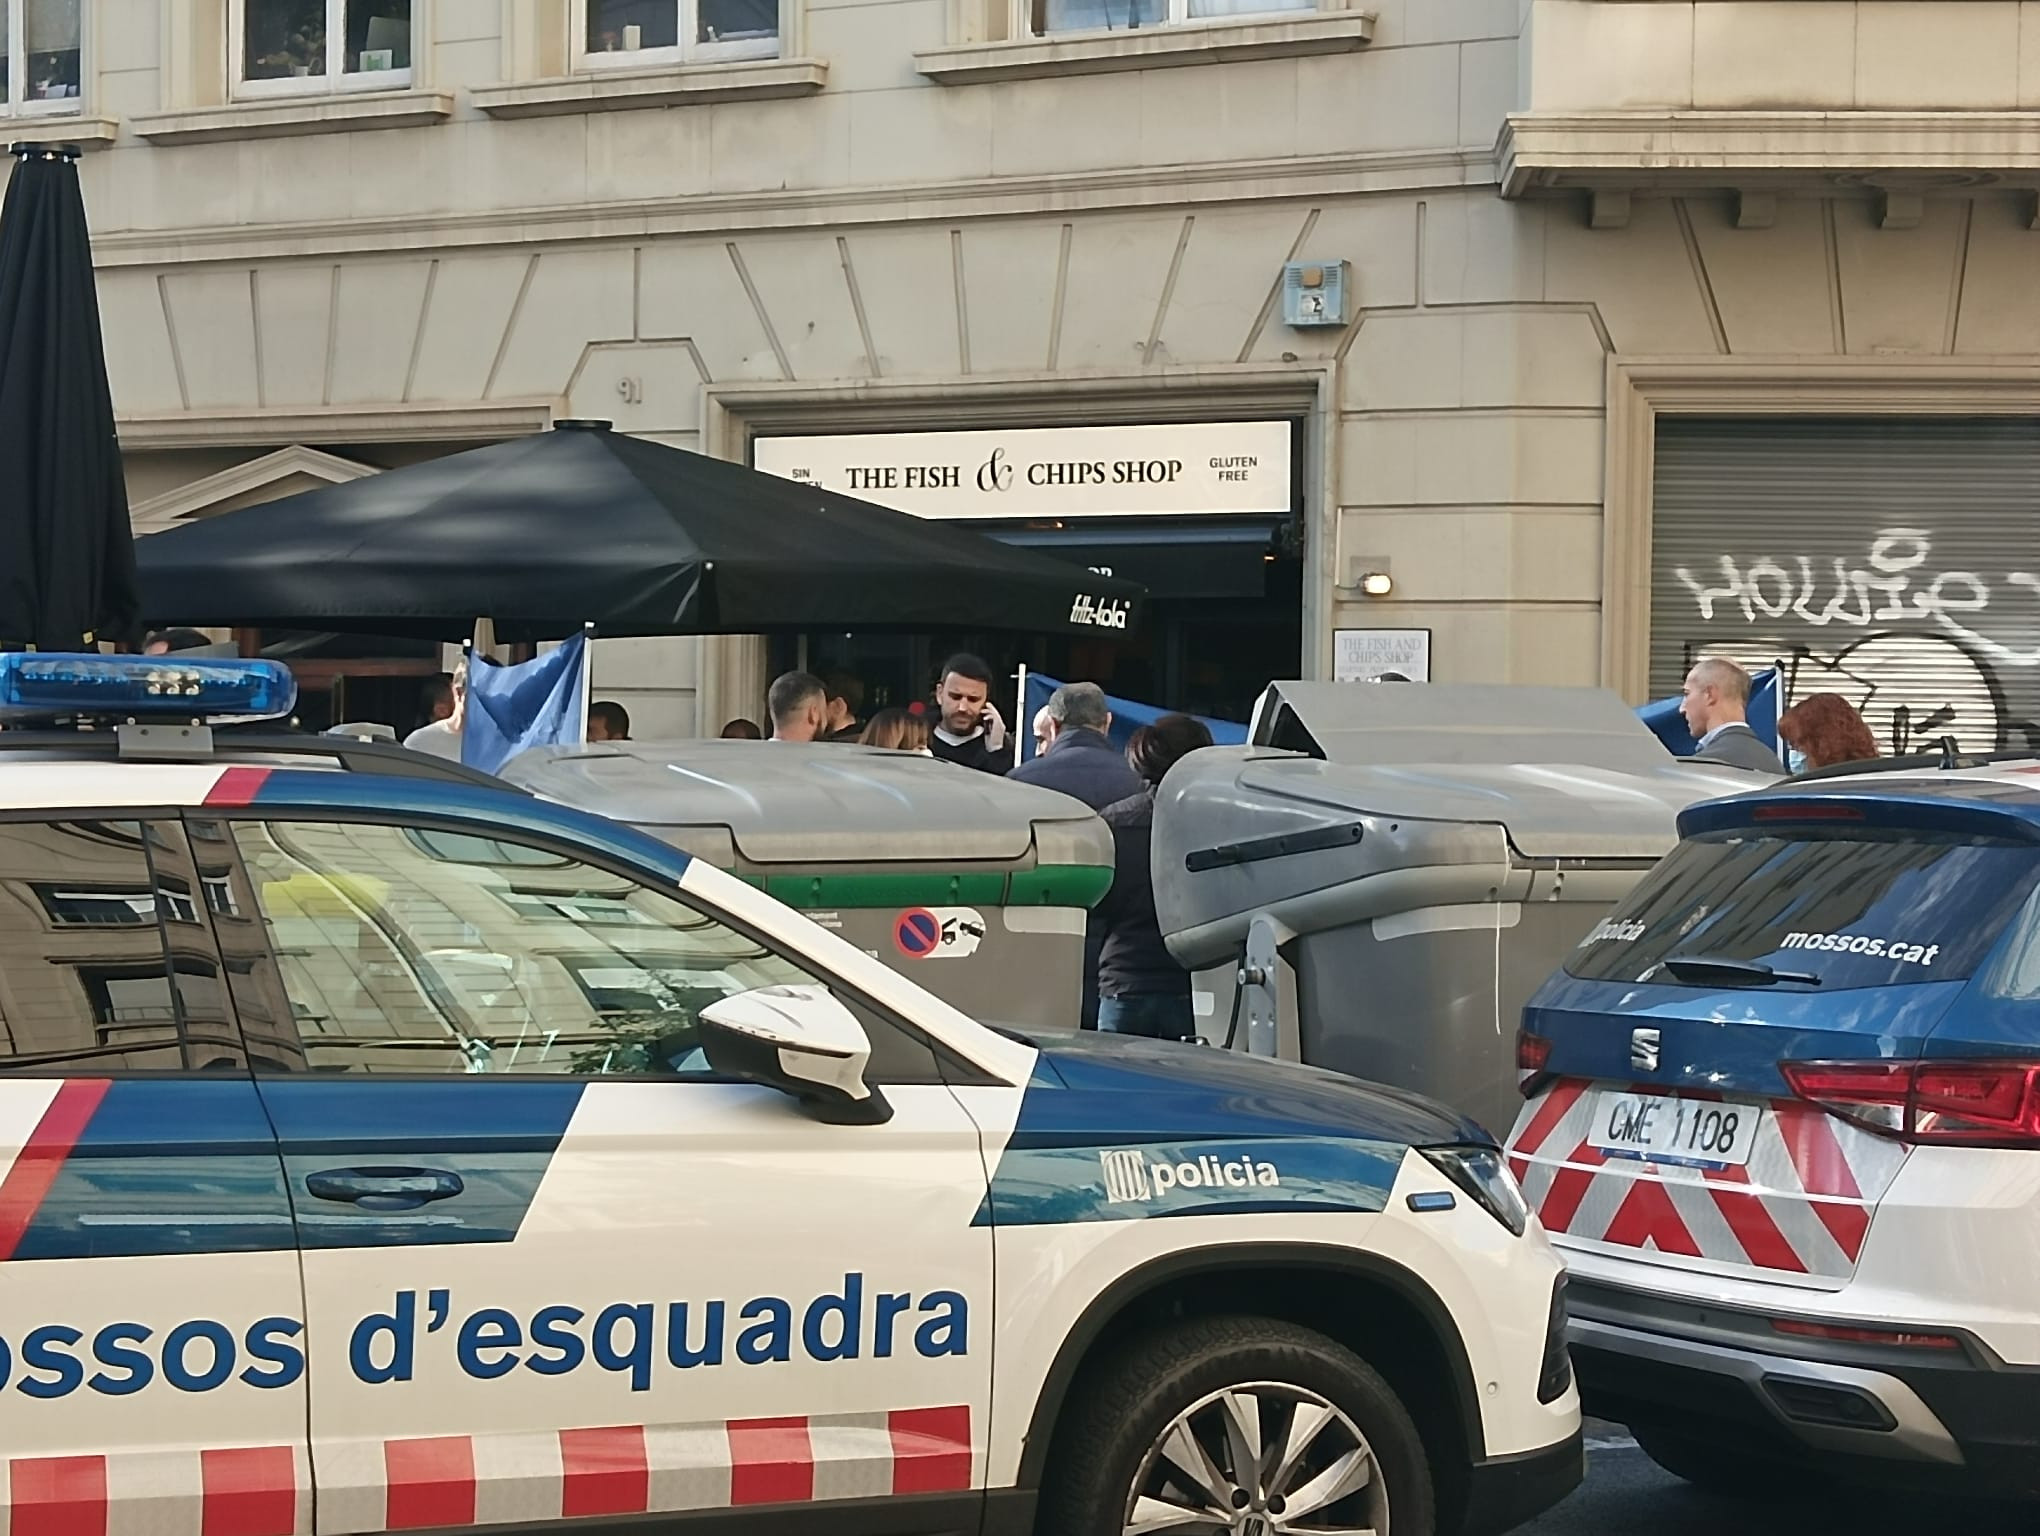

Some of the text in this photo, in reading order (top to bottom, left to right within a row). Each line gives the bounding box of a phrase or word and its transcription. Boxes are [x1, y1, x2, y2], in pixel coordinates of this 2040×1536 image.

[616, 377, 642, 404] 91
[792, 468, 810, 479] SIN
[845, 466, 897, 489] THE
[904, 465, 960, 488] FISH
[976, 447, 1014, 492] &
[1027, 461, 1105, 485] CHIPS
[1112, 460, 1182, 484] SHOP
[1209, 456, 1258, 469] GLUTEN
[1218, 470, 1249, 482] FREE
[1342, 638, 1421, 650] THE FISH AND
[1348, 651, 1413, 664] CHIPS SHOP
[1780, 932, 1939, 966] mossos.cat
[1607, 1100, 1739, 1154] CME 1108
[1151, 1155, 1280, 1197] policia
[0, 1272, 969, 1399] ssos d'esquadra
